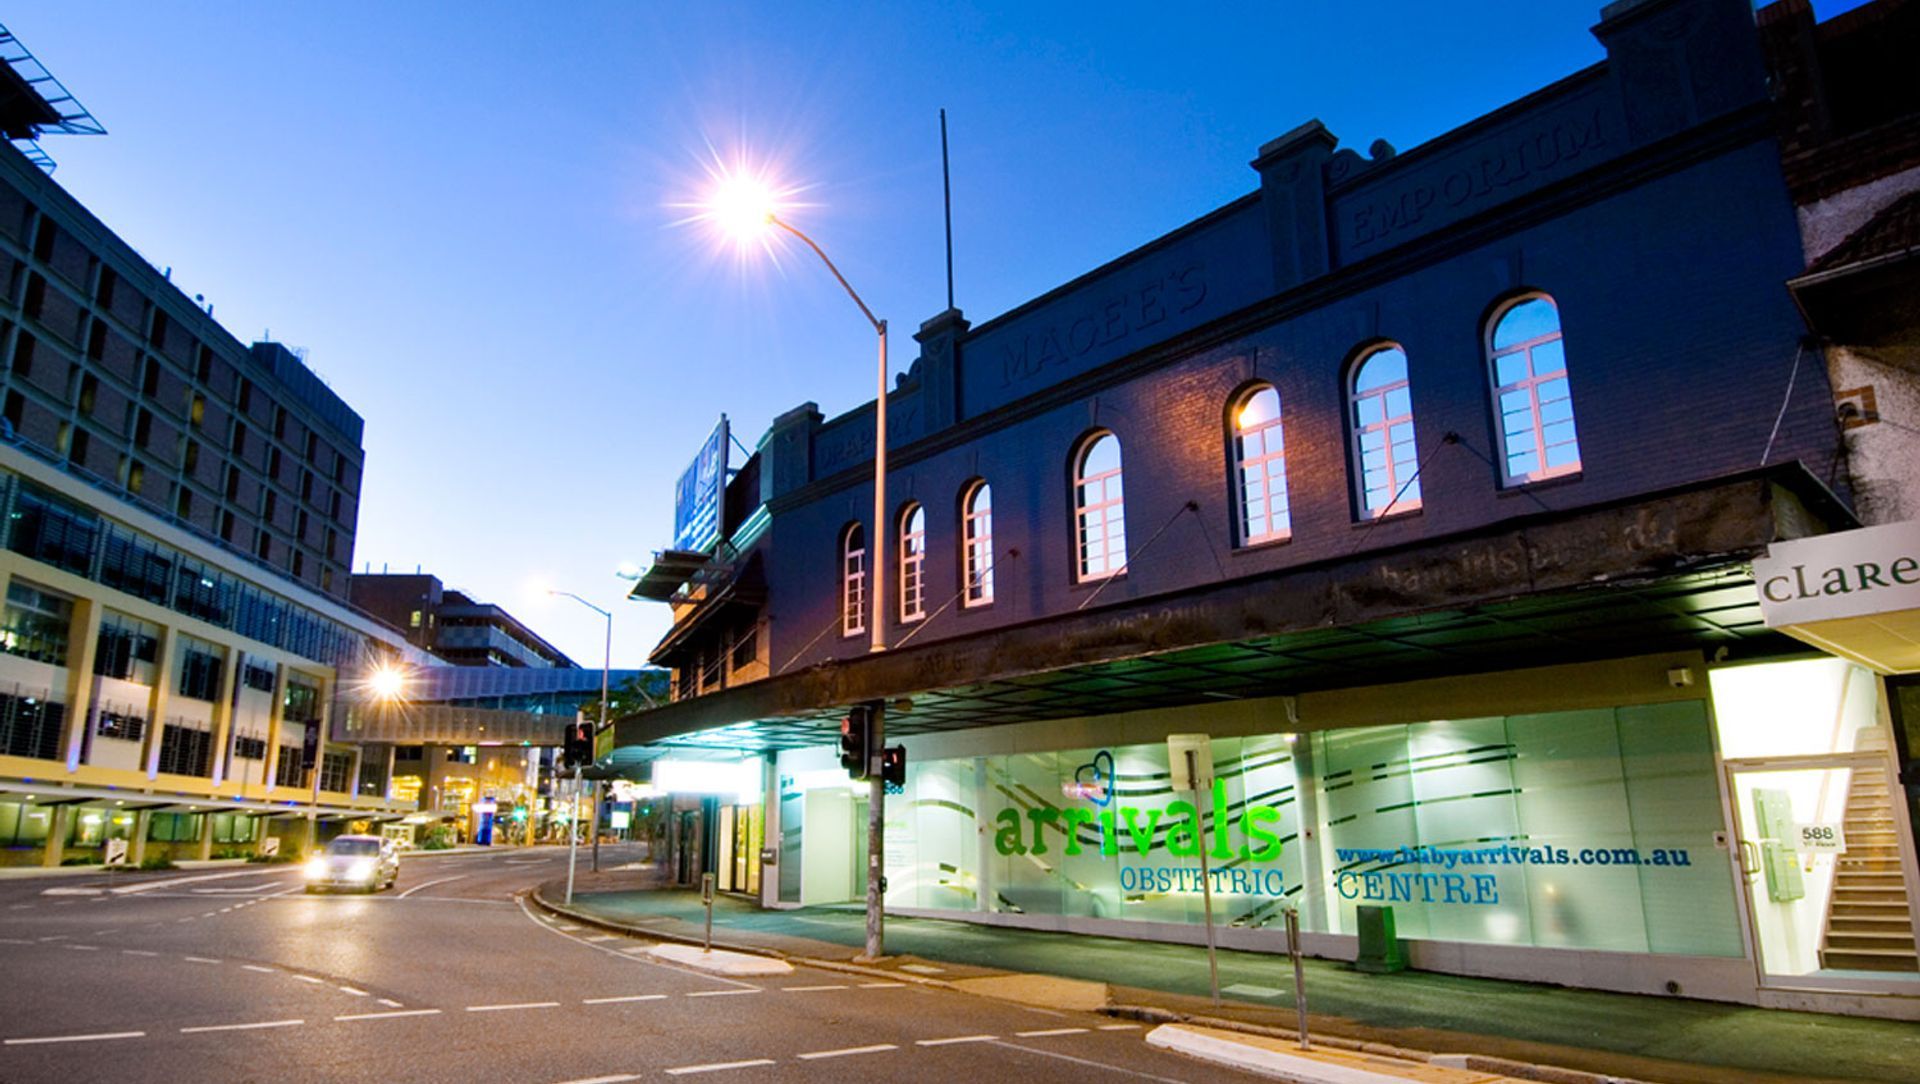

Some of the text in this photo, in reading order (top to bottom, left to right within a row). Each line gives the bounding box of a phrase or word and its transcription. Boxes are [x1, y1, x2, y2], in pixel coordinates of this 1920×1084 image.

[995, 777, 1283, 862] arrivals
[1802, 827, 1833, 839] 588
[1335, 843, 1691, 868] www.babyarrivals.com.au
[1120, 865, 1498, 904] OBSTETRIC CENTRE
